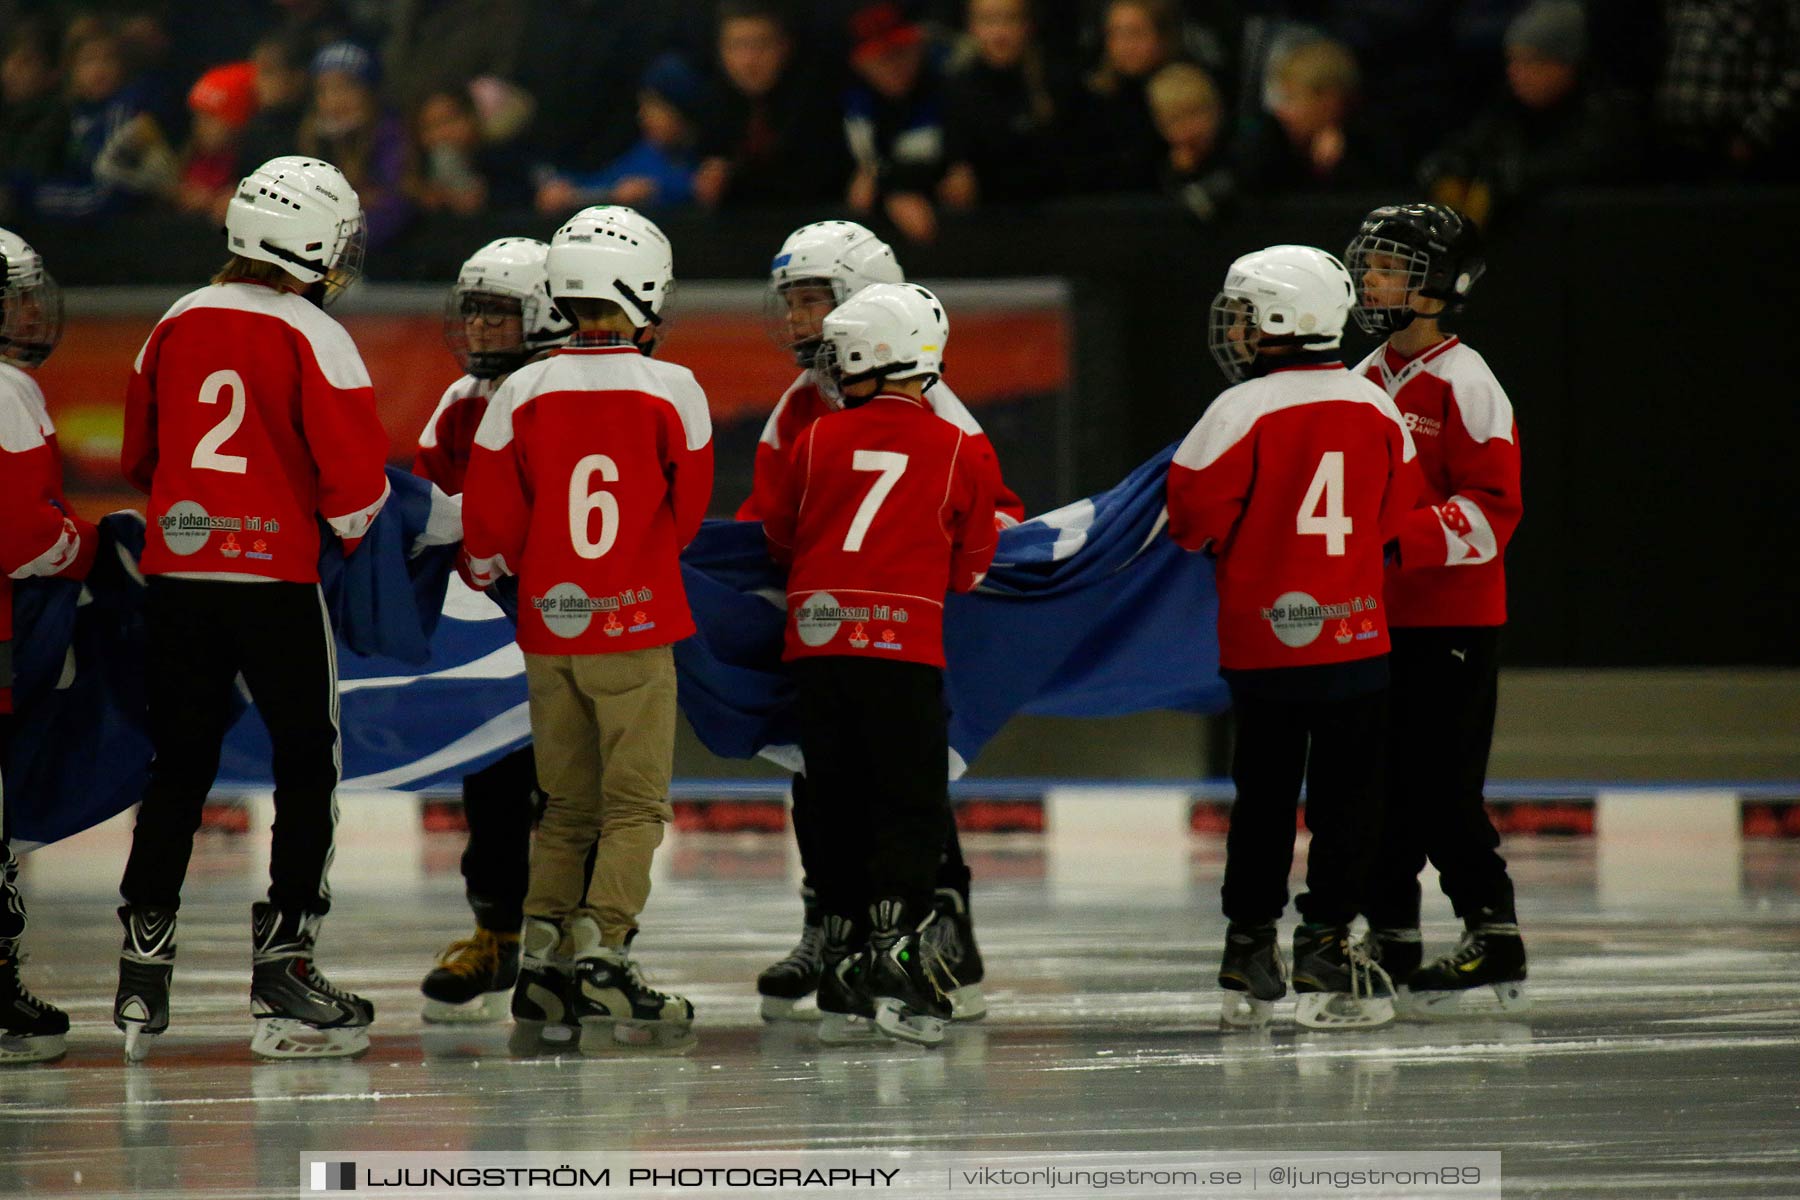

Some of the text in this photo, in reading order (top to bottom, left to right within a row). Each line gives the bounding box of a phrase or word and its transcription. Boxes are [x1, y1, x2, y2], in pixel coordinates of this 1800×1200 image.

[191, 369, 248, 474] 2
[179, 512, 242, 531] johansson
[264, 518, 279, 533] ab
[569, 454, 619, 559] 6
[843, 450, 909, 552] 7
[1297, 451, 1353, 556] 4
[560, 593, 619, 611] johansson
[637, 586, 653, 602] ab
[813, 603, 870, 620] johansson
[873, 604, 890, 620] bil
